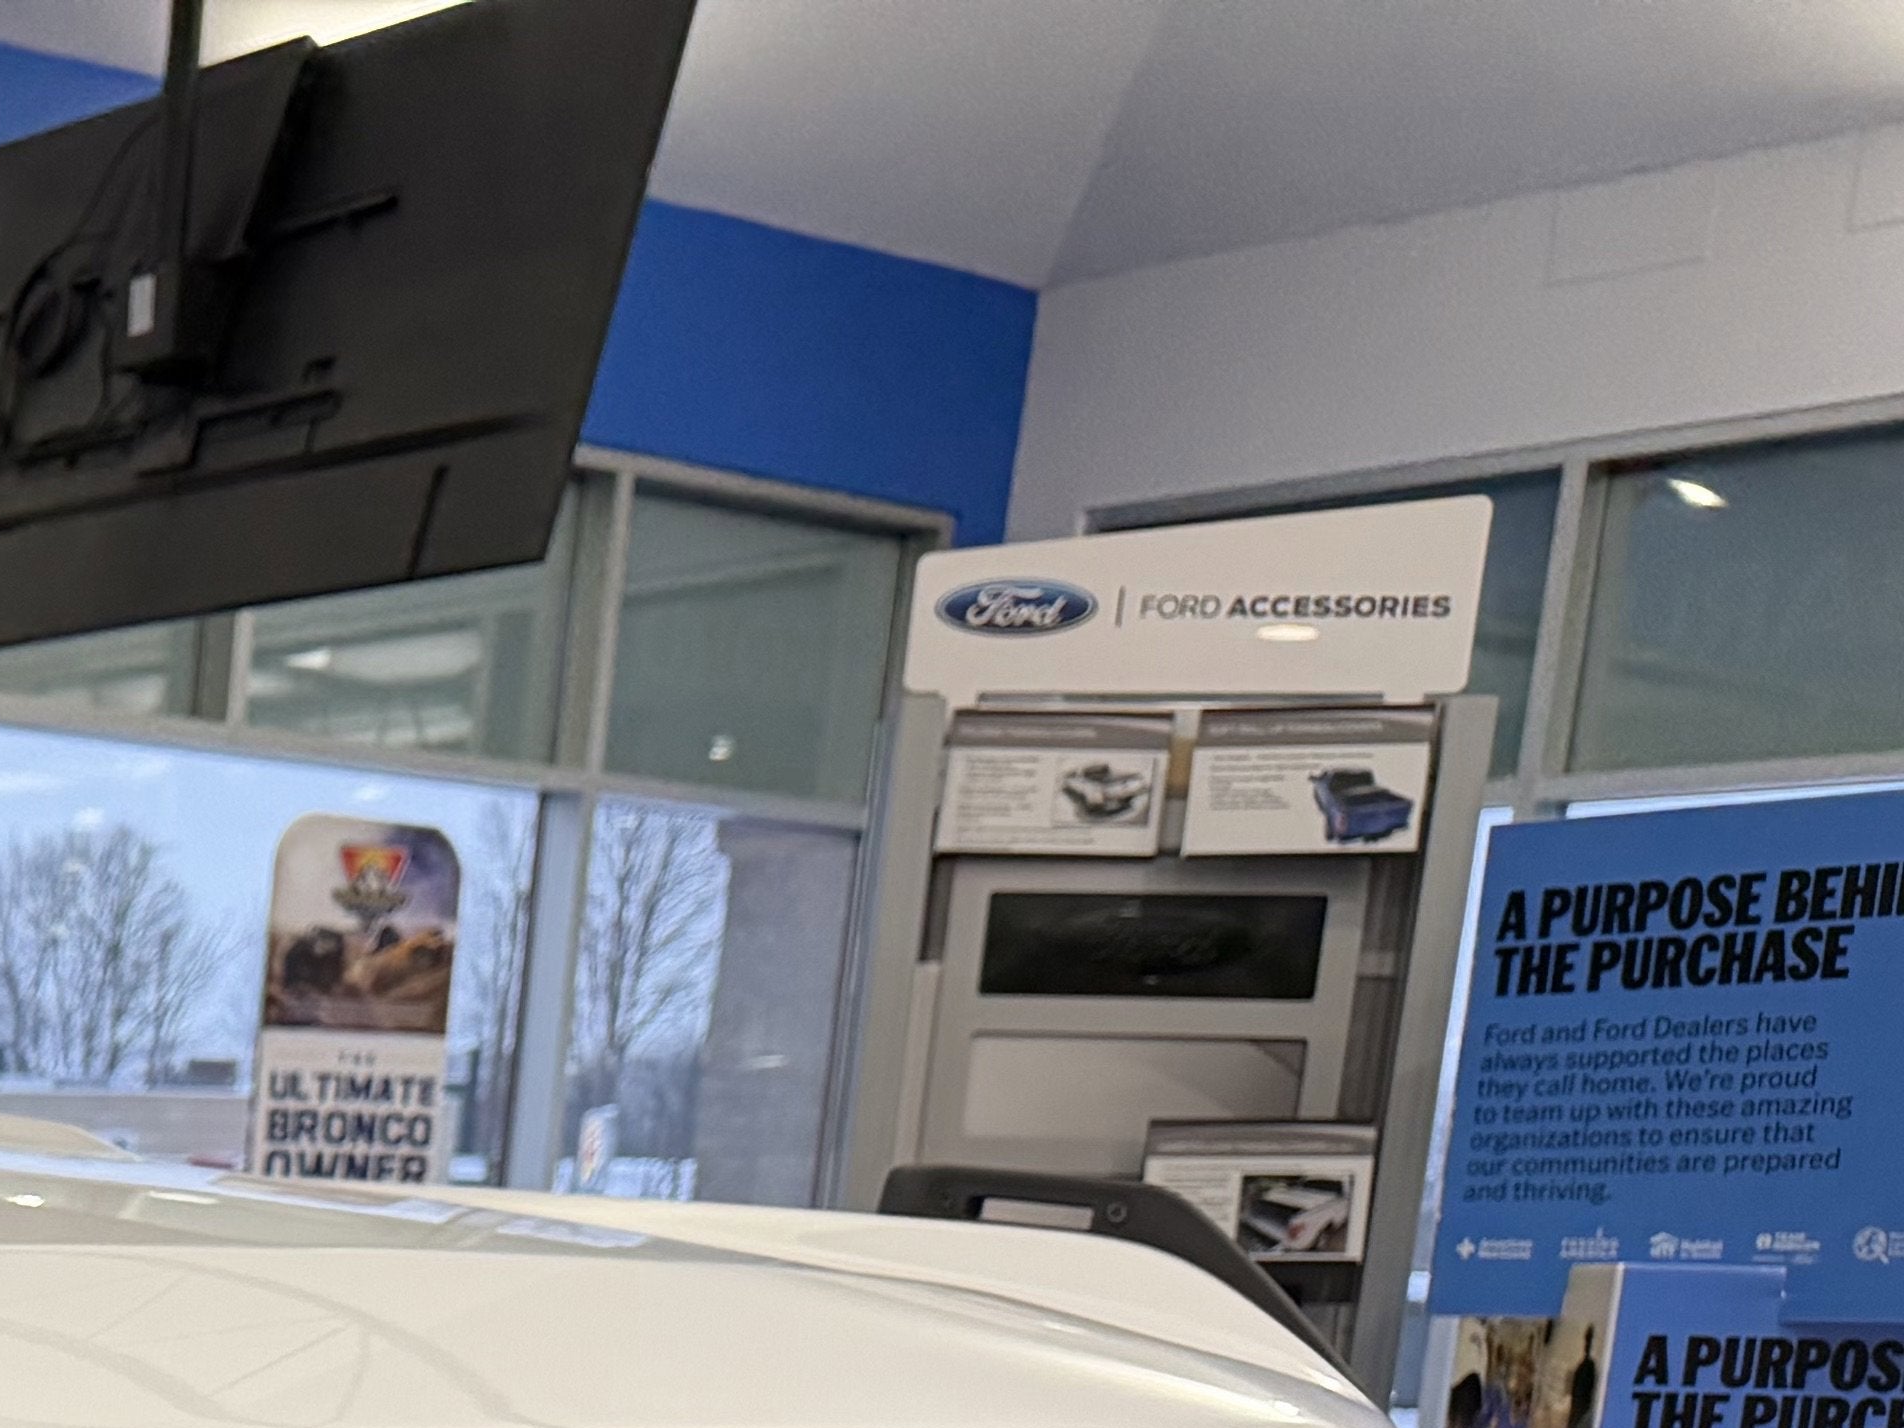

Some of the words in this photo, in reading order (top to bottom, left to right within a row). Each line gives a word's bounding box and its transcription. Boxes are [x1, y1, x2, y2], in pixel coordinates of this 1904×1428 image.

[967, 586, 1068, 629] Ford
[1139, 594, 1224, 620] FORD
[1227, 595, 1451, 620] ACCESSORIES
[1496, 890, 1526, 941] A
[1538, 872, 1766, 939] PURPOSE
[1773, 861, 1904, 924] BEHI
[1495, 943, 1580, 996] THE
[1587, 925, 1855, 992] PURCHASE
[1484, 1022, 1536, 1047] Ford
[1541, 1020, 1586, 1044] and
[1594, 1017, 1646, 1042] Ford
[1654, 1015, 1748, 1040] Dealers
[1756, 1012, 1816, 1035] have
[1481, 1052, 1559, 1076] always
[1566, 1044, 1691, 1070] supported
[1699, 1043, 1738, 1064] the
[1745, 1039, 1828, 1067] places
[270, 1071, 435, 1106] ULTIMATE
[1478, 1079, 1528, 1099] they
[1534, 1074, 1576, 1096] call
[1582, 1072, 1656, 1094] home.
[1665, 1070, 1734, 1091] We're
[1741, 1066, 1817, 1094] proud
[268, 1108, 432, 1147] BRONCO
[1474, 1106, 1496, 1125] to
[1503, 1103, 1563, 1123] team
[1569, 1105, 1602, 1127] up
[1607, 1099, 1658, 1120] with
[1665, 1097, 1734, 1118] these
[1741, 1094, 1853, 1120] amazing
[1470, 1126, 1632, 1154] organizations
[1638, 1126, 1662, 1146] to
[1670, 1125, 1754, 1144] ensure
[1763, 1121, 1815, 1143] that
[1467, 1157, 1504, 1175] our
[1511, 1153, 1669, 1175] communities
[1676, 1154, 1715, 1171] are
[1724, 1148, 1841, 1175] prepared
[1464, 1182, 1506, 1201] and
[1514, 1180, 1616, 1204] thriving.
[1633, 1335, 1668, 1386] A
[1682, 1335, 1904, 1393] PURPOS
